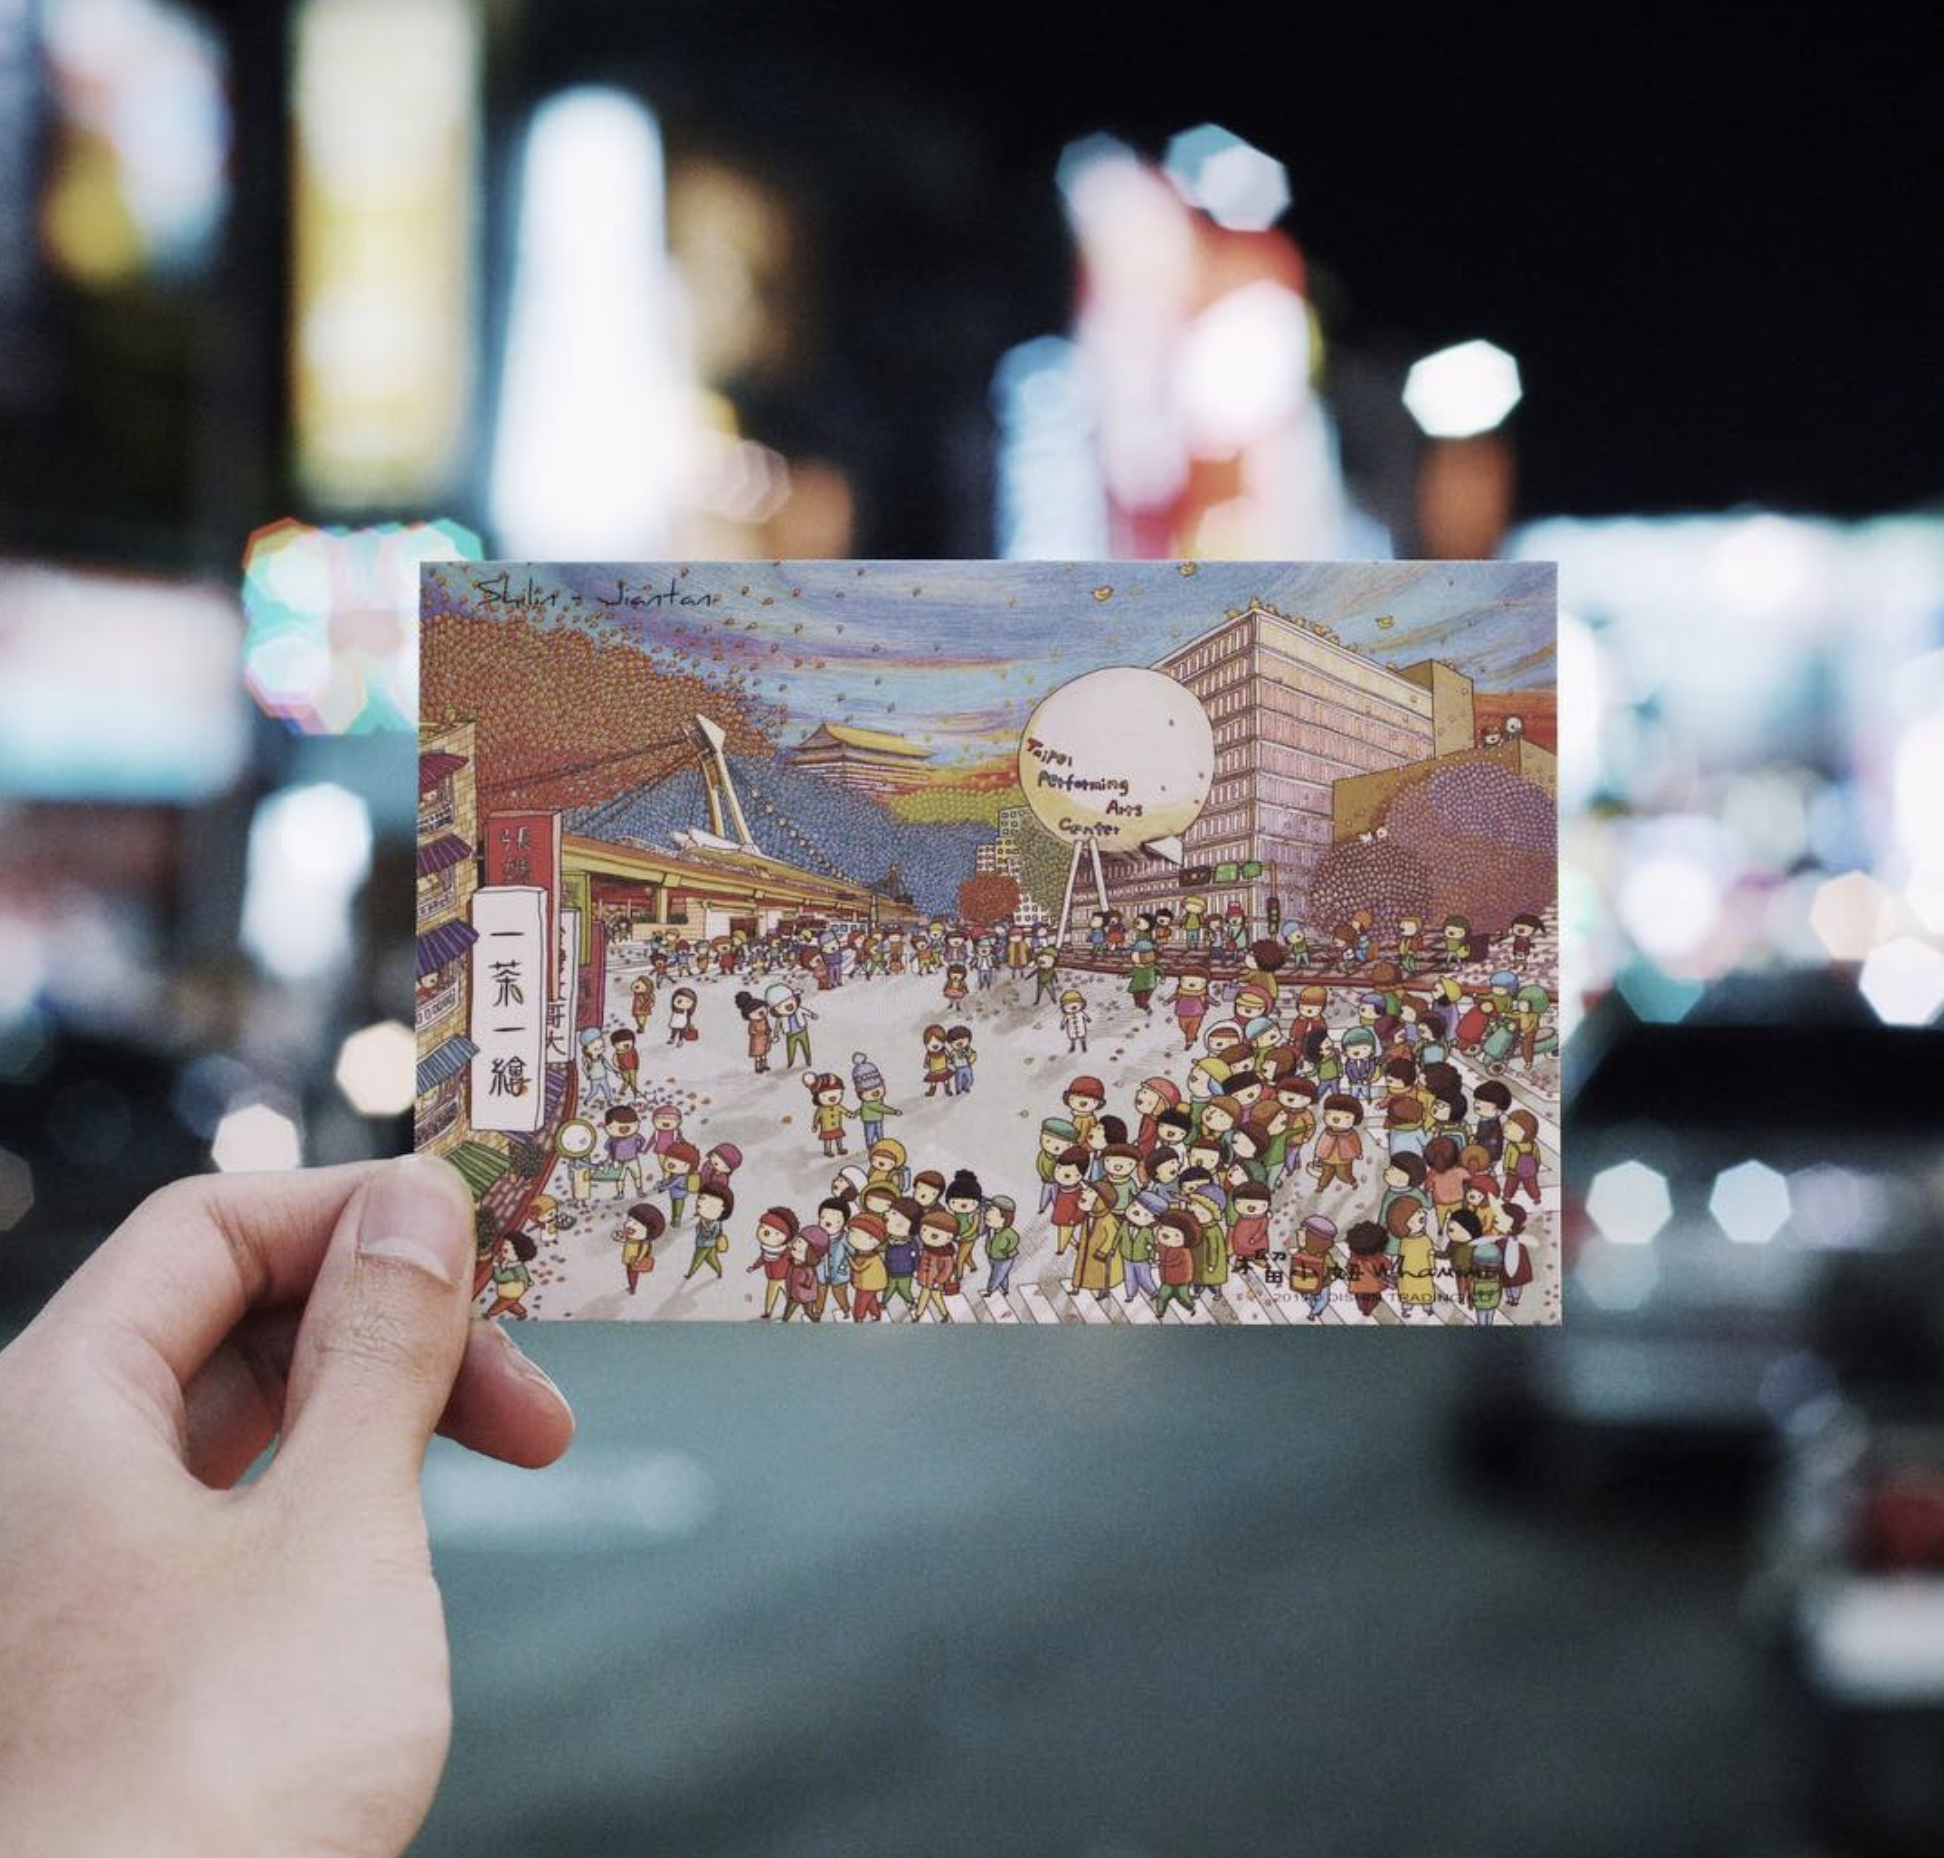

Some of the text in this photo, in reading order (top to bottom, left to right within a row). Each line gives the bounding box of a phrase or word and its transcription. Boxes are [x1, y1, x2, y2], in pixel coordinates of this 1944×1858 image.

[477, 574, 556, 606] Shilin
[597, 578, 711, 606] Jiantan
[1037, 770, 1129, 796] Performing
[1105, 799, 1143, 817] Arts
[1058, 817, 1120, 836] Center
